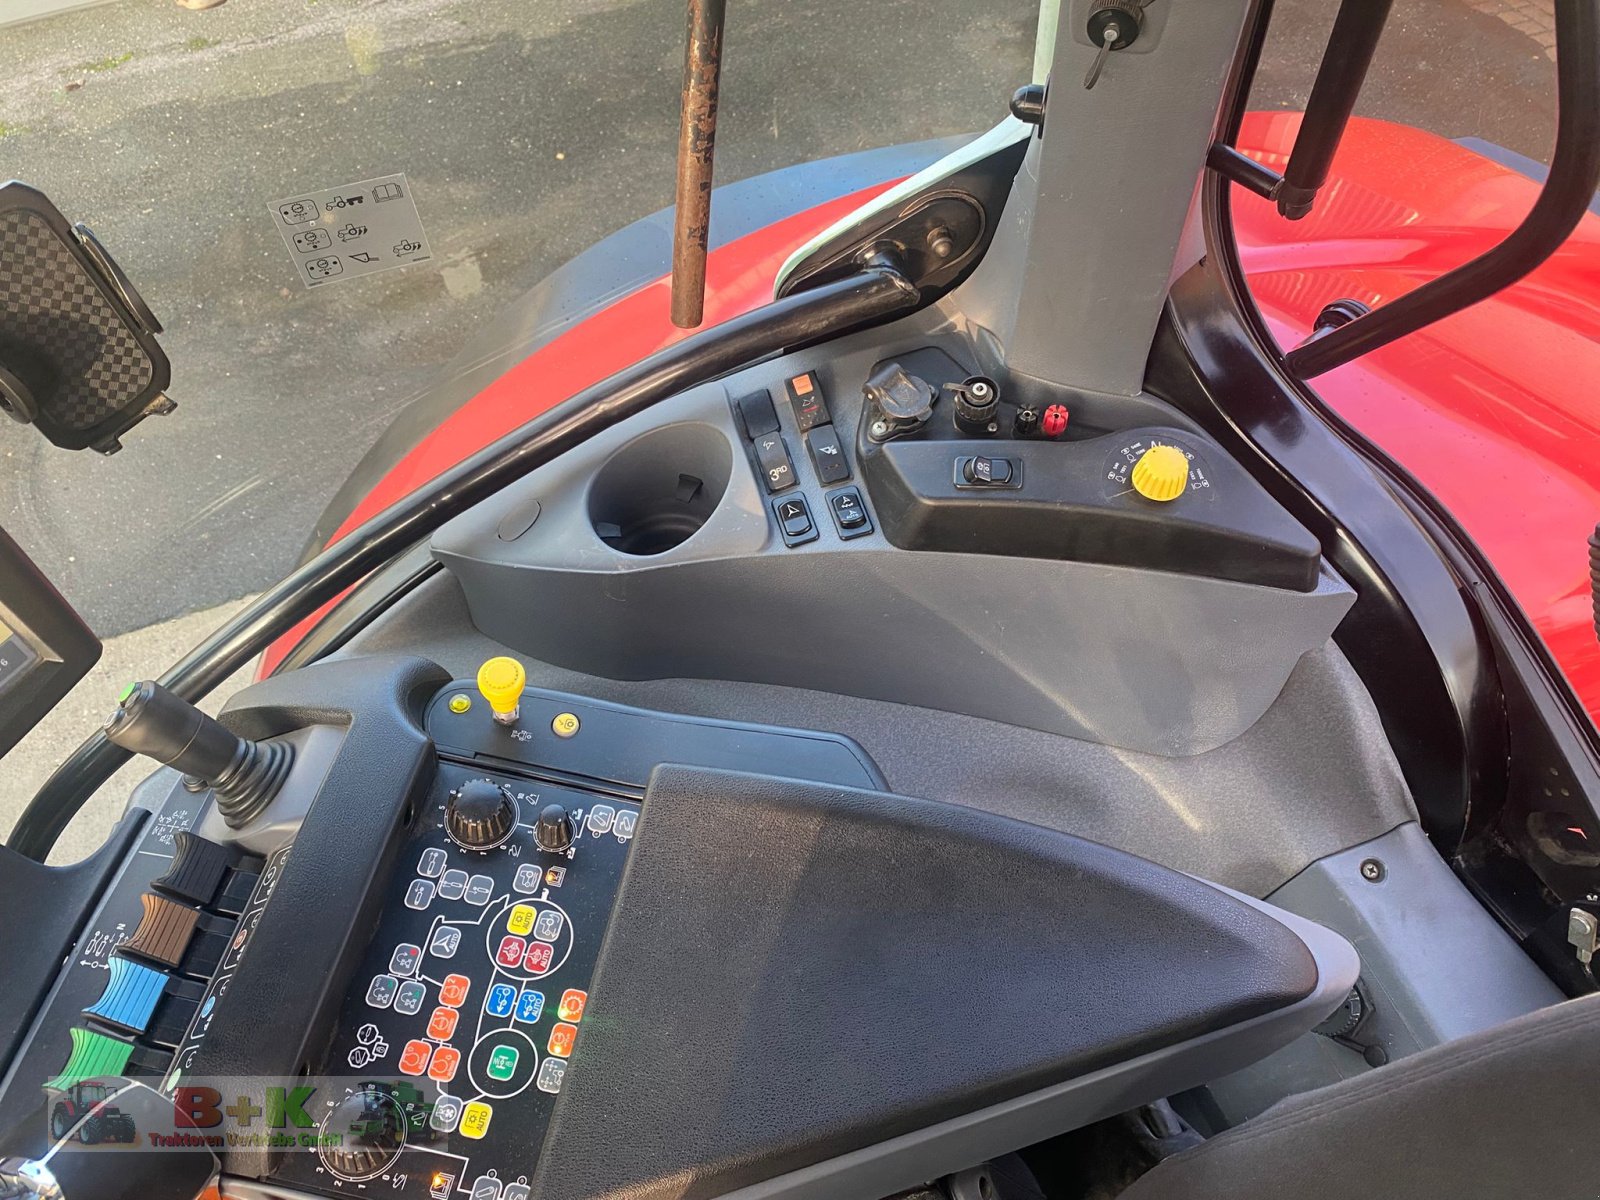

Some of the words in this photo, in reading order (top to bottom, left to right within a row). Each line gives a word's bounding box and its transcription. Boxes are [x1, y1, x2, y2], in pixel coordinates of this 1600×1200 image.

[769, 465, 788, 481] 3RD
[522, 911, 533, 930] AUTO
[448, 932, 459, 951] AUTO
[540, 949, 551, 968] AUTO
[531, 998, 542, 1018] AUTO
[405, 1102, 415, 1112] 10
[476, 1110, 488, 1132] AUTO
[316, 1166, 325, 1174] 3
